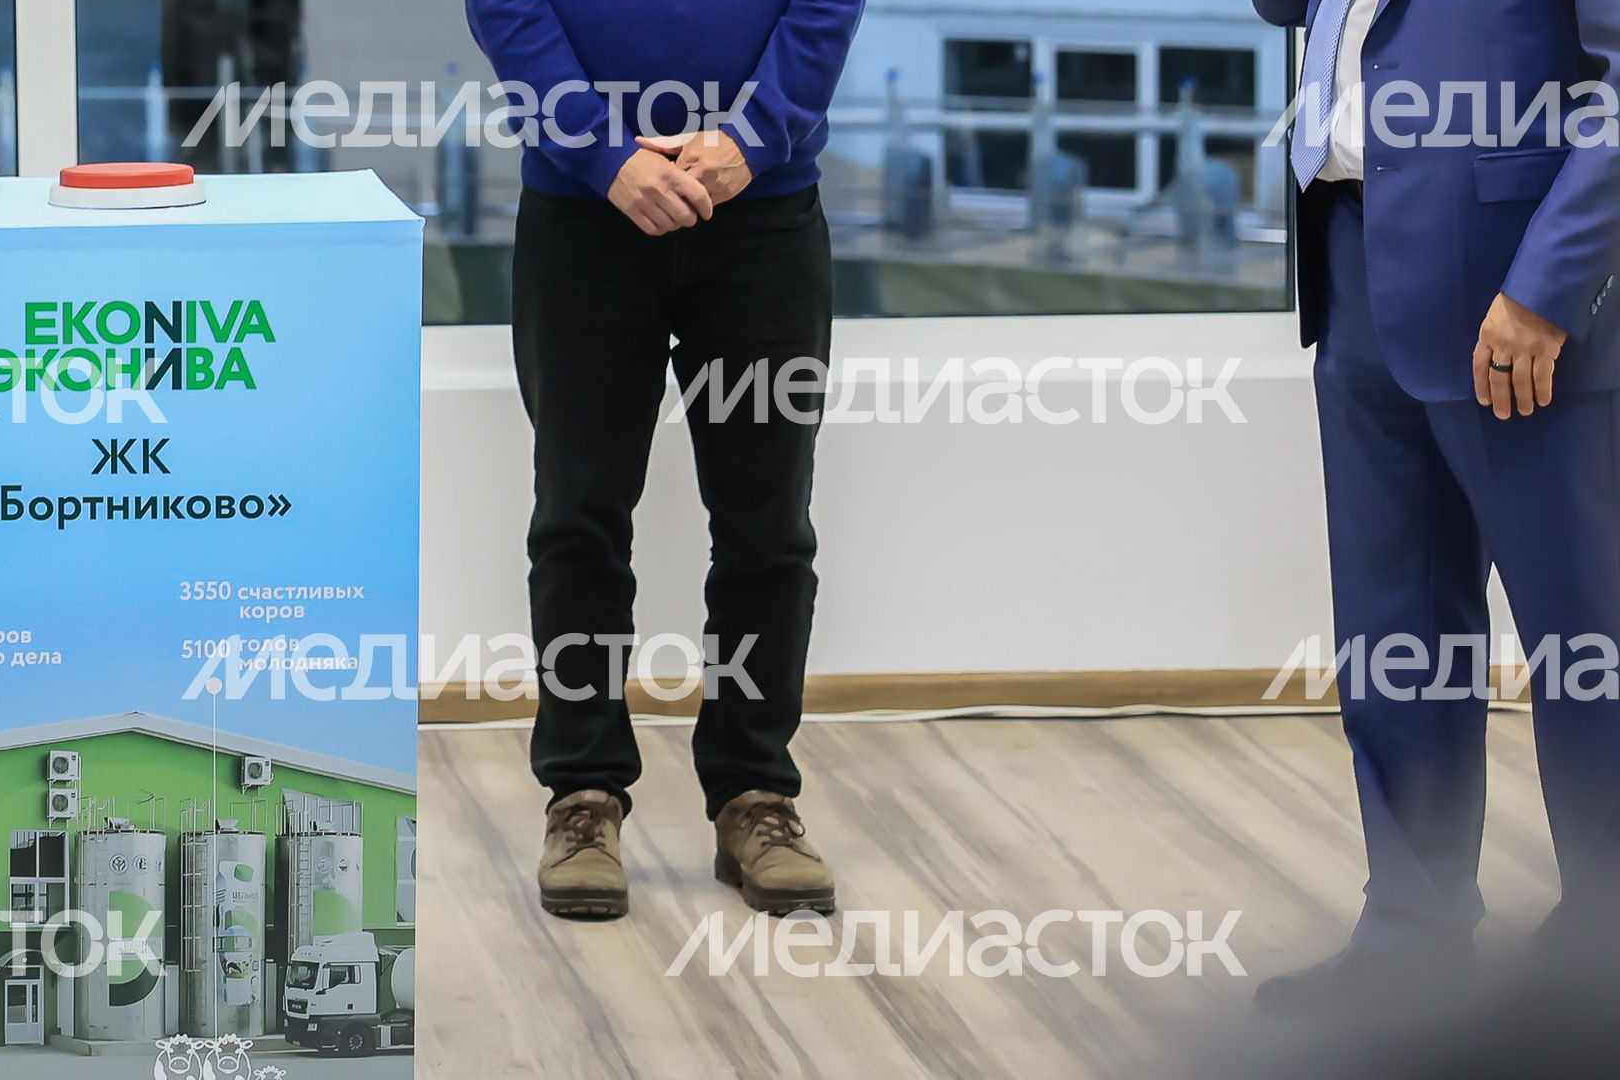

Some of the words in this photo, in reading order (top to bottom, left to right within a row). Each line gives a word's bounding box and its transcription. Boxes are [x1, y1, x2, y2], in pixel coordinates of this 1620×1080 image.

[25, 300, 276, 345] EKONIVA
[91, 437, 171, 474] ЖК
[179, 581, 232, 601] 3550
[237, 585, 365, 600] счастливых
[239, 604, 305, 623] коров
[181, 638, 230, 659] 5100
[10, 650, 63, 668] дела
[238, 655, 359, 674] молодняка
